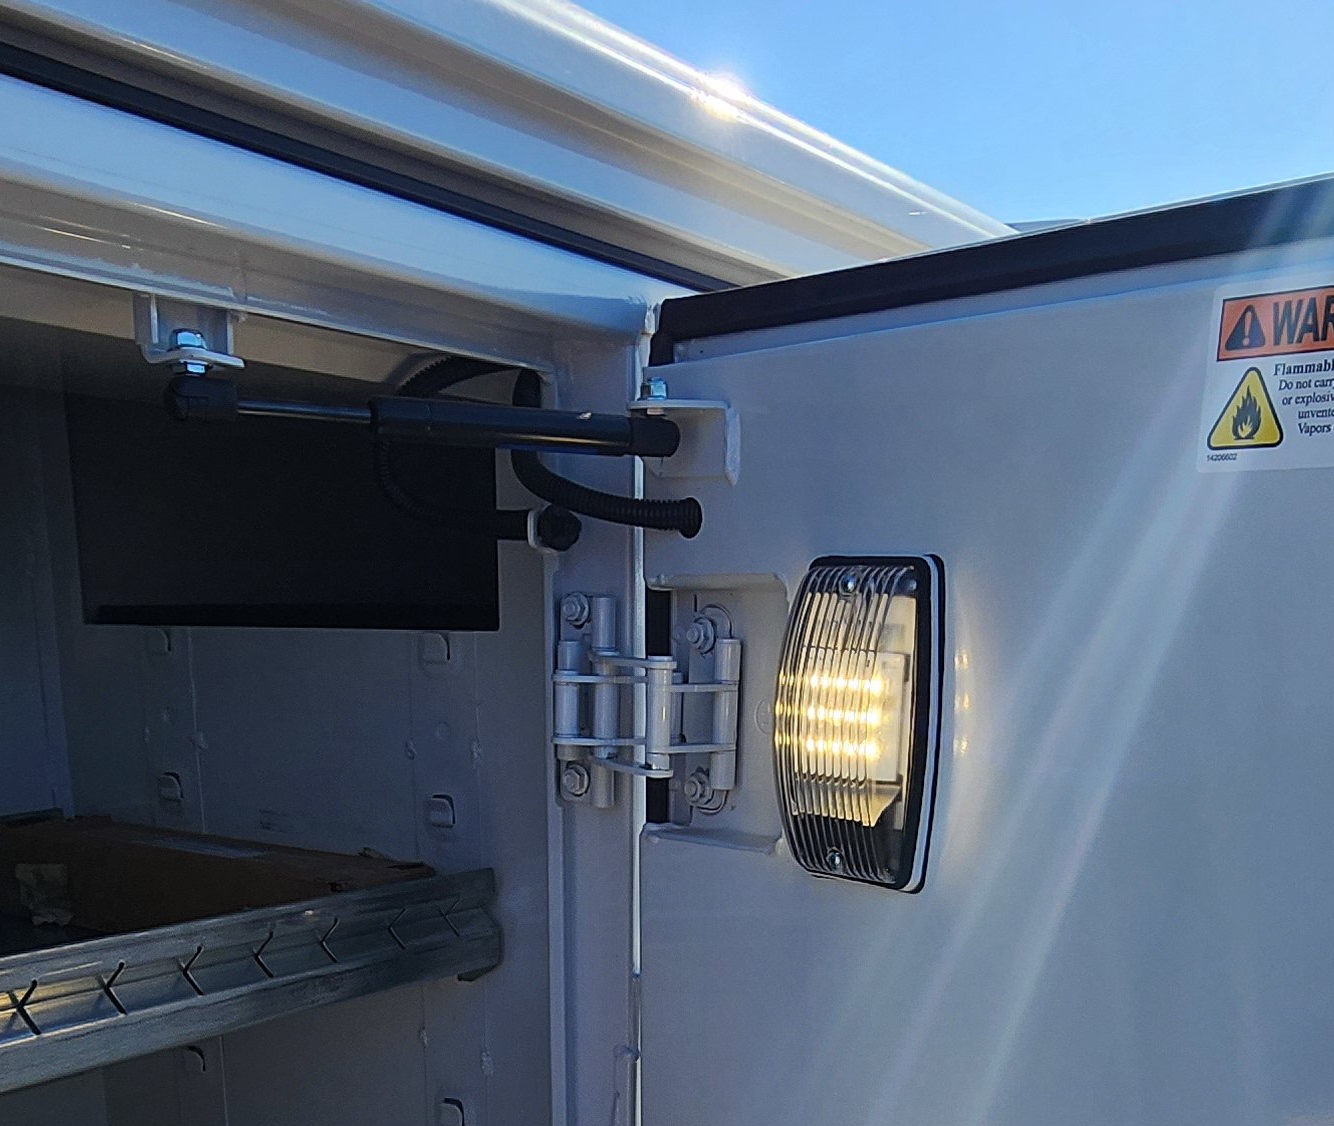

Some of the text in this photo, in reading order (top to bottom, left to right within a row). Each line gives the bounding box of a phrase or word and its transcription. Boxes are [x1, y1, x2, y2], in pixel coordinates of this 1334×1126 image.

[1278, 379, 1293, 391] Do
[1295, 379, 1312, 389] not
[1282, 395, 1292, 405] or
[1297, 422, 1331, 436] Vapors
